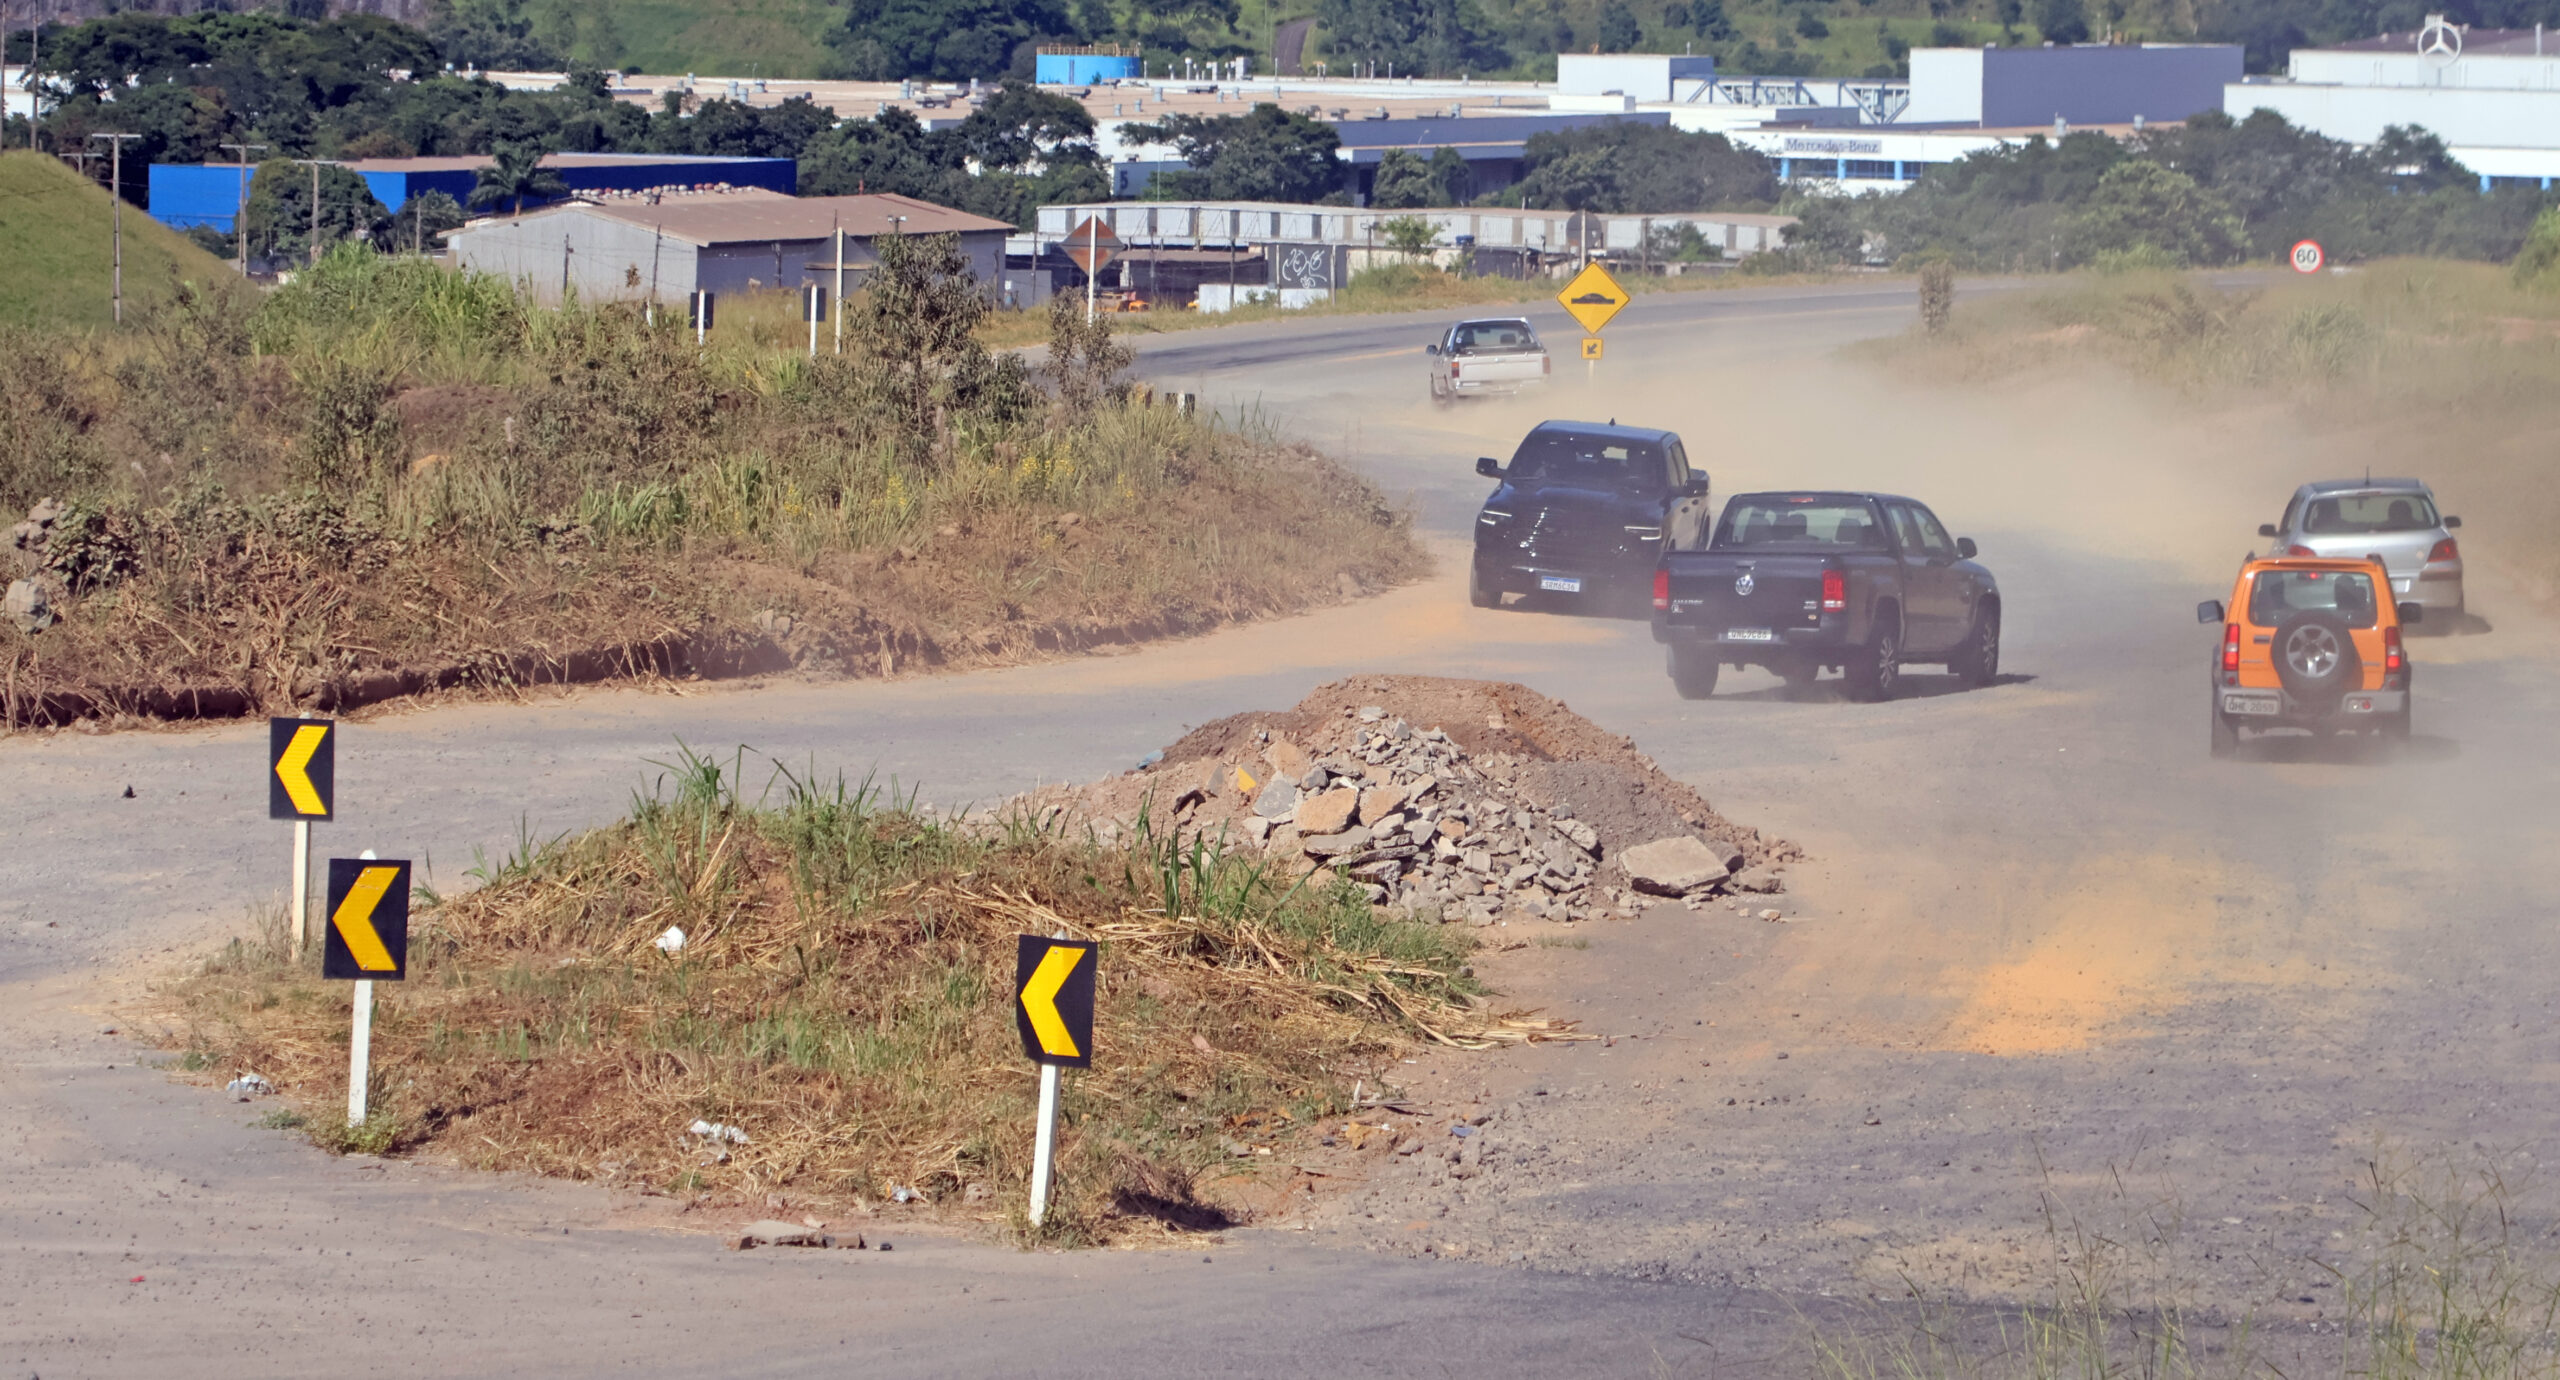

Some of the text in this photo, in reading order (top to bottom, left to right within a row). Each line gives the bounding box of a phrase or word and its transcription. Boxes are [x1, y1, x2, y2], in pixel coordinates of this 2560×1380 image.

[1785, 138, 1879, 154] Mercedes-Benz
[1120, 170, 1129, 190] 5
[2296, 248, 2317, 264] 60
